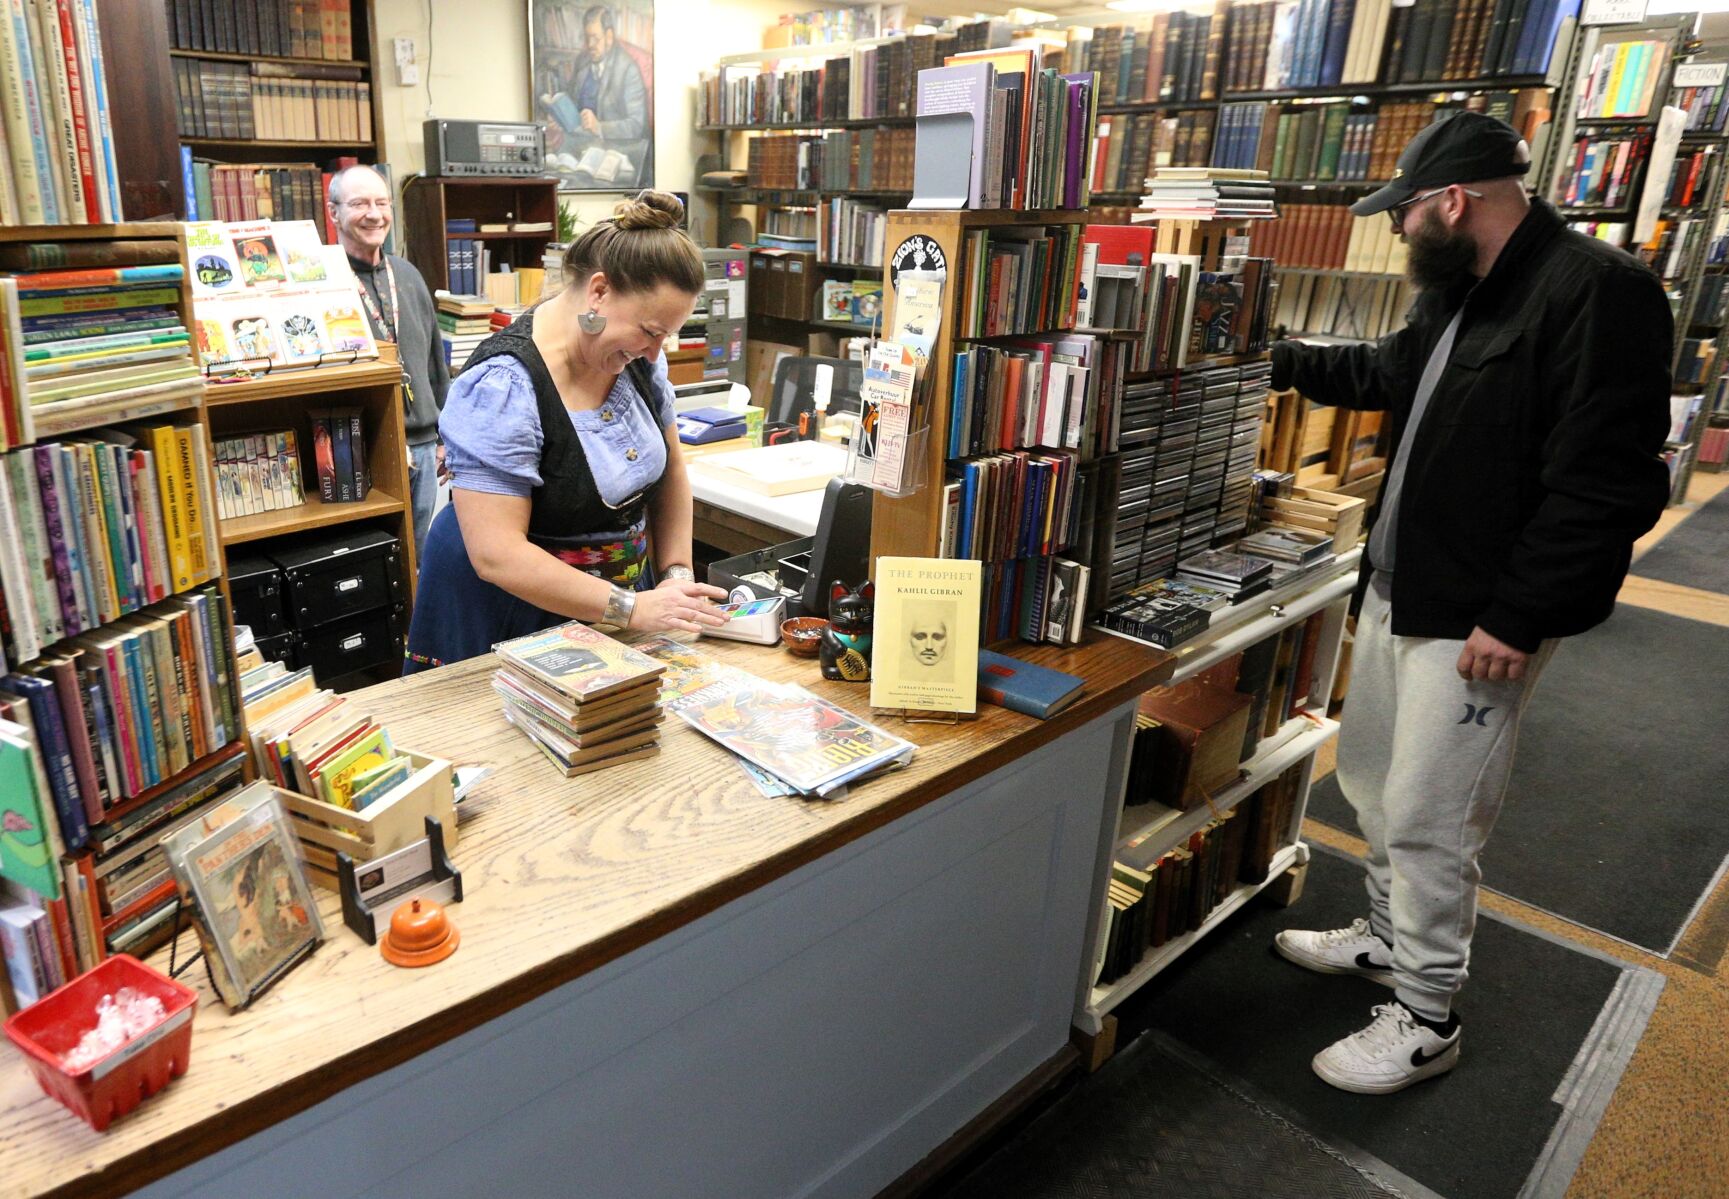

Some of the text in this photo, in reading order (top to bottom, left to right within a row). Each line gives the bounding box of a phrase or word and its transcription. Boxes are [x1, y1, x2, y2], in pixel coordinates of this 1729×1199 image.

[1679, 66, 1720, 82] FICTION
[10, 76, 22, 120] AMERICA
[64, 119, 81, 202] GREAT DISASTERS
[892, 236, 923, 270] ZION'S
[883, 406, 906, 418] FREE
[180, 438, 192, 480] DAMNED
[168, 475, 177, 503] MODERN
[323, 476, 333, 500] FURY
[185, 491, 196, 507] You
[888, 569, 974, 581] THE PROPHET
[897, 587, 963, 596] KAHLIL GIBRAN
[174, 656, 183, 684] ROCKS
[181, 696, 191, 742] NERALS
[62, 755, 71, 766] NO
[65, 766, 75, 784] HAIR
[68, 784, 79, 799] DAY
